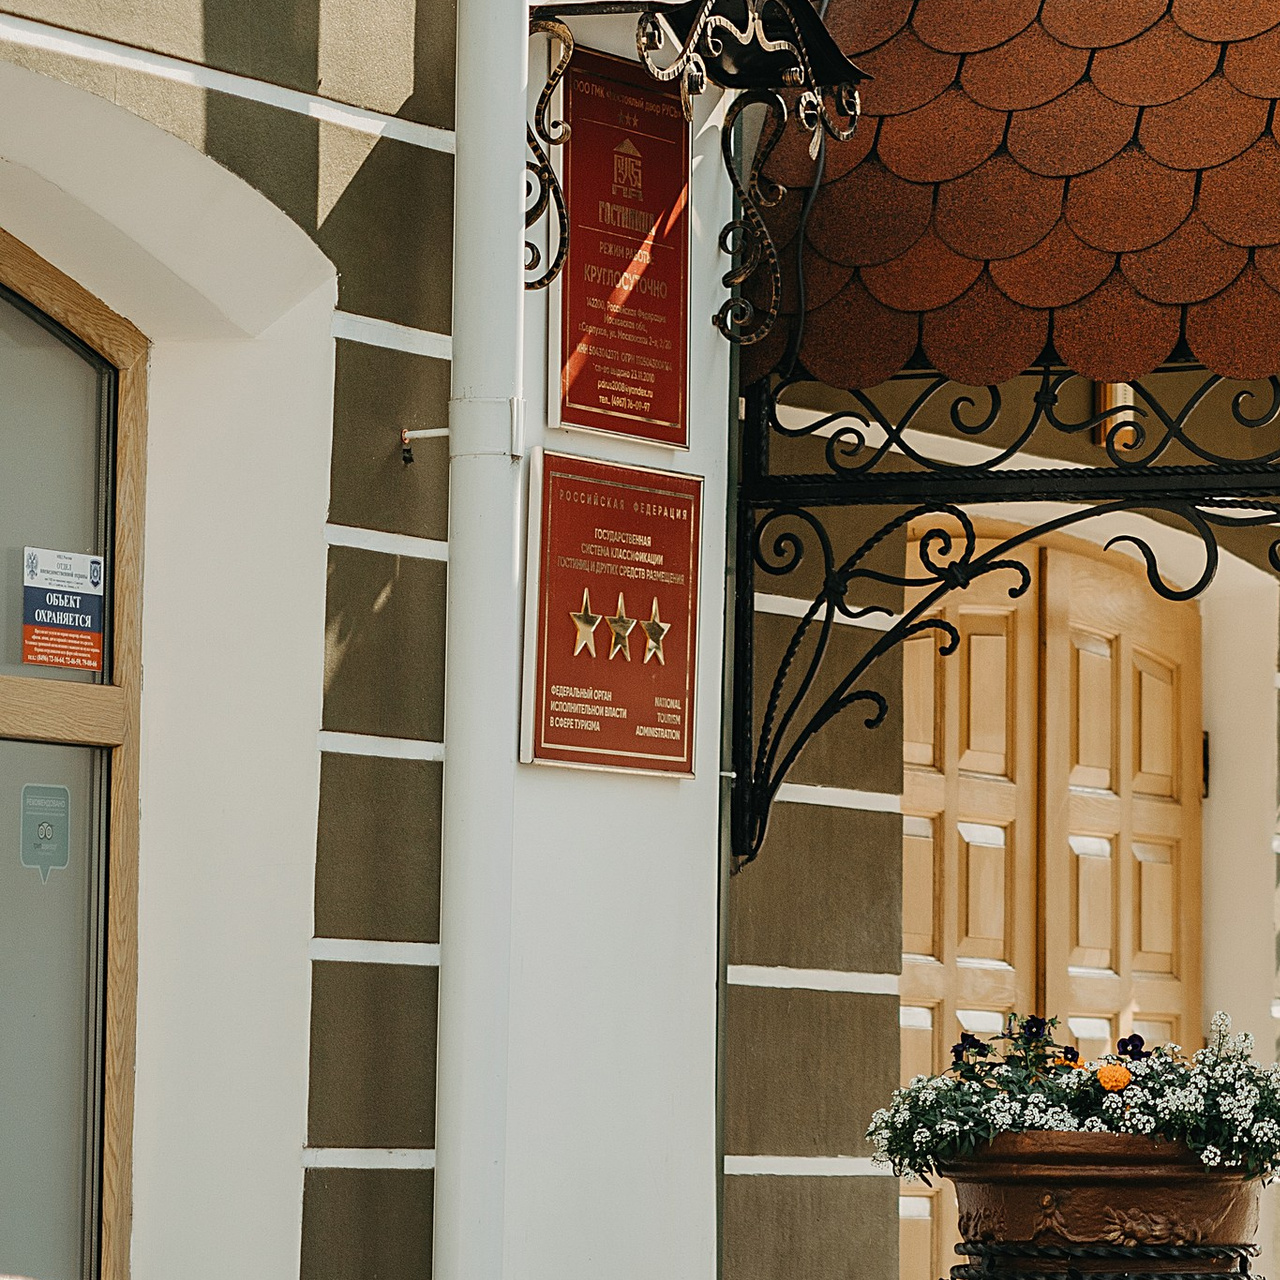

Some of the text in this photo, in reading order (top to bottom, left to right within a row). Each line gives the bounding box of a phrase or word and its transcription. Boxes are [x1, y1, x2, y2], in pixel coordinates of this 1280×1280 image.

[599, 241, 625, 258] РЕЖИМ
[584, 263, 668, 299] КРУГЛОСУТОЧНО
[559, 489, 688, 522] РОССИЙСКАЯ ФЕДЕРАЦИЯ
[594, 527, 652, 547] ГОСУДАРСТВЕННАЯ
[581, 542, 664, 566] СИСТЕМА КЛАССИФИКАЦИИ
[56, 562, 72, 572] ОТДЕЛ
[558, 555, 590, 573] ГОСТИНИЦ
[619, 565, 646, 580] СРЕДСТВ
[646, 568, 685, 586] РАЗМЕЩЕНИЯ
[46, 592, 82, 609] ОБЪЕКТ
[34, 608, 92, 628] ОХРАНЯЕТСЯ
[551, 684, 613, 702] ФЕДЕРАЛЬНЫЙ ОРГАН
[654, 696, 682, 710] NATIONAL
[604, 706, 628, 719] ВЛАСТИ
[657, 712, 681, 725] TOURISM
[550, 716, 601, 732] В СФЕРЕ ТУРИЗМА
[636, 725, 681, 741] ADMINISTRATION
